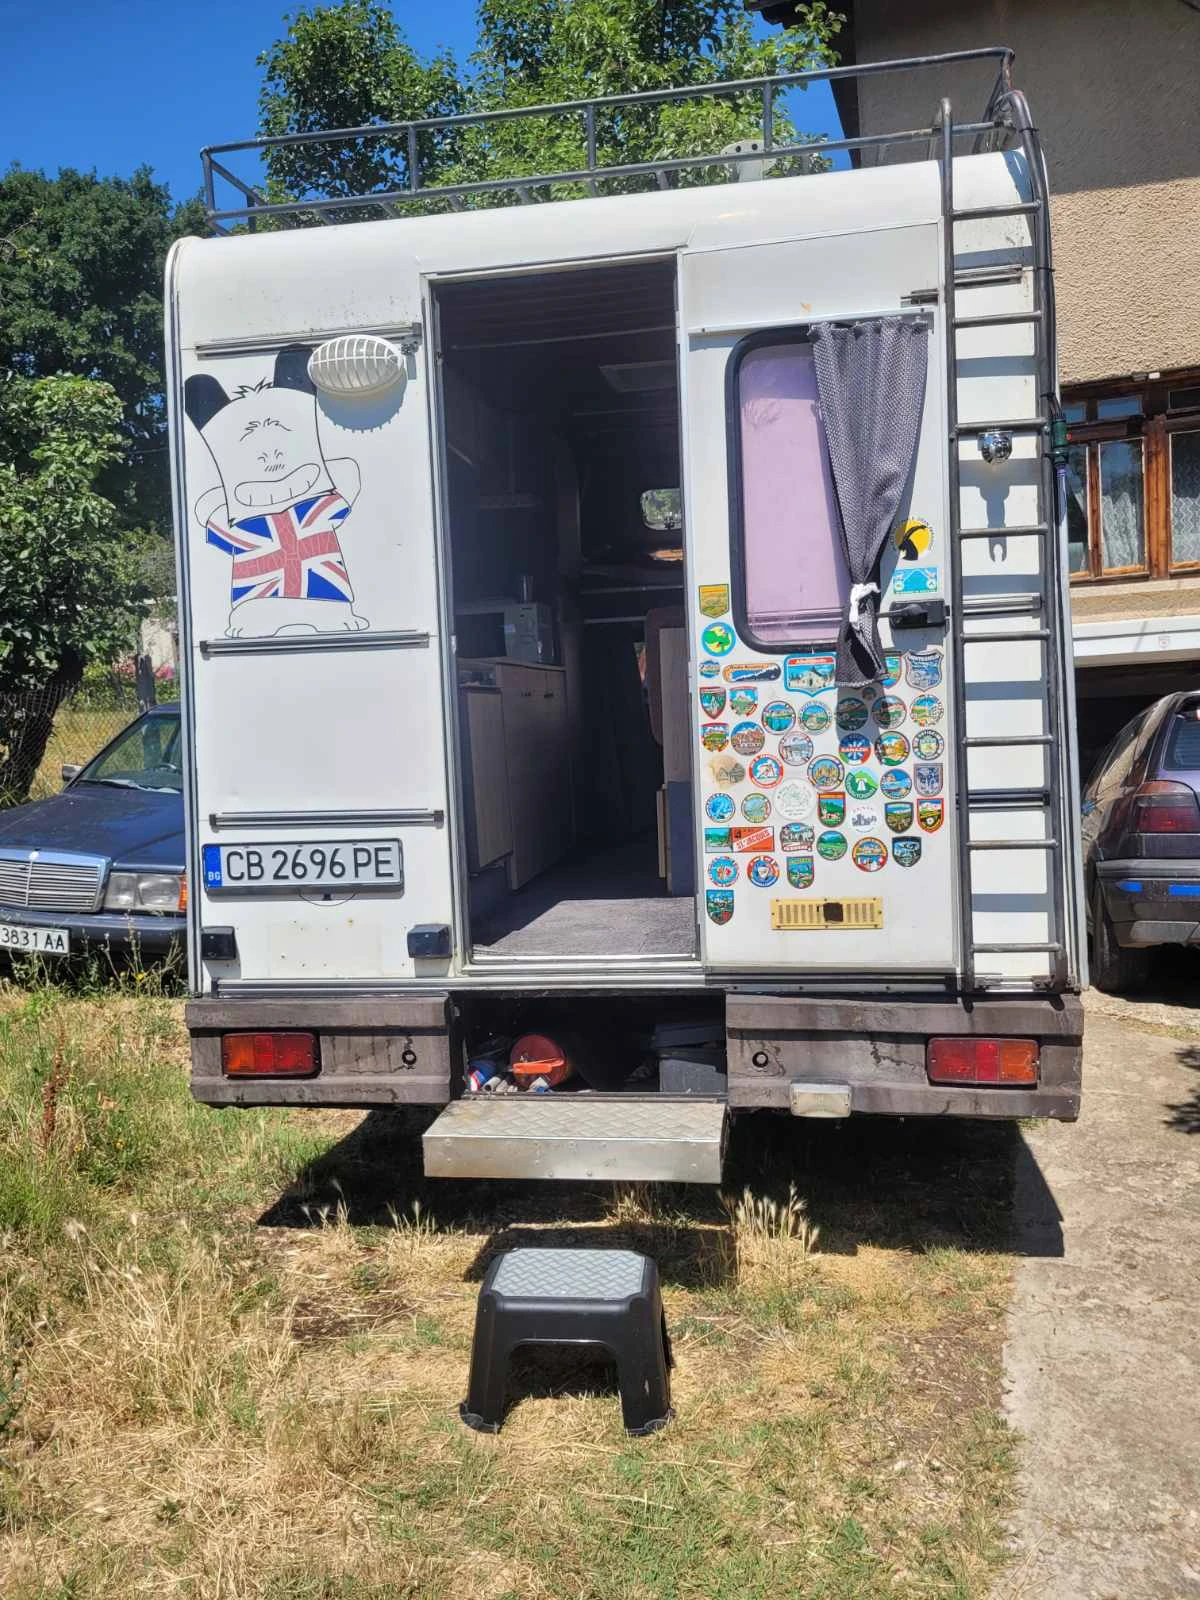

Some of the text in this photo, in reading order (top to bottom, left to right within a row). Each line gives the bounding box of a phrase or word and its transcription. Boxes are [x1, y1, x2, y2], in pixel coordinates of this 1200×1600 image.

[226, 847, 394, 881] CB 2696 PE
[208, 872, 221, 881] BG
[2, 927, 65, 950] 3831 AA
